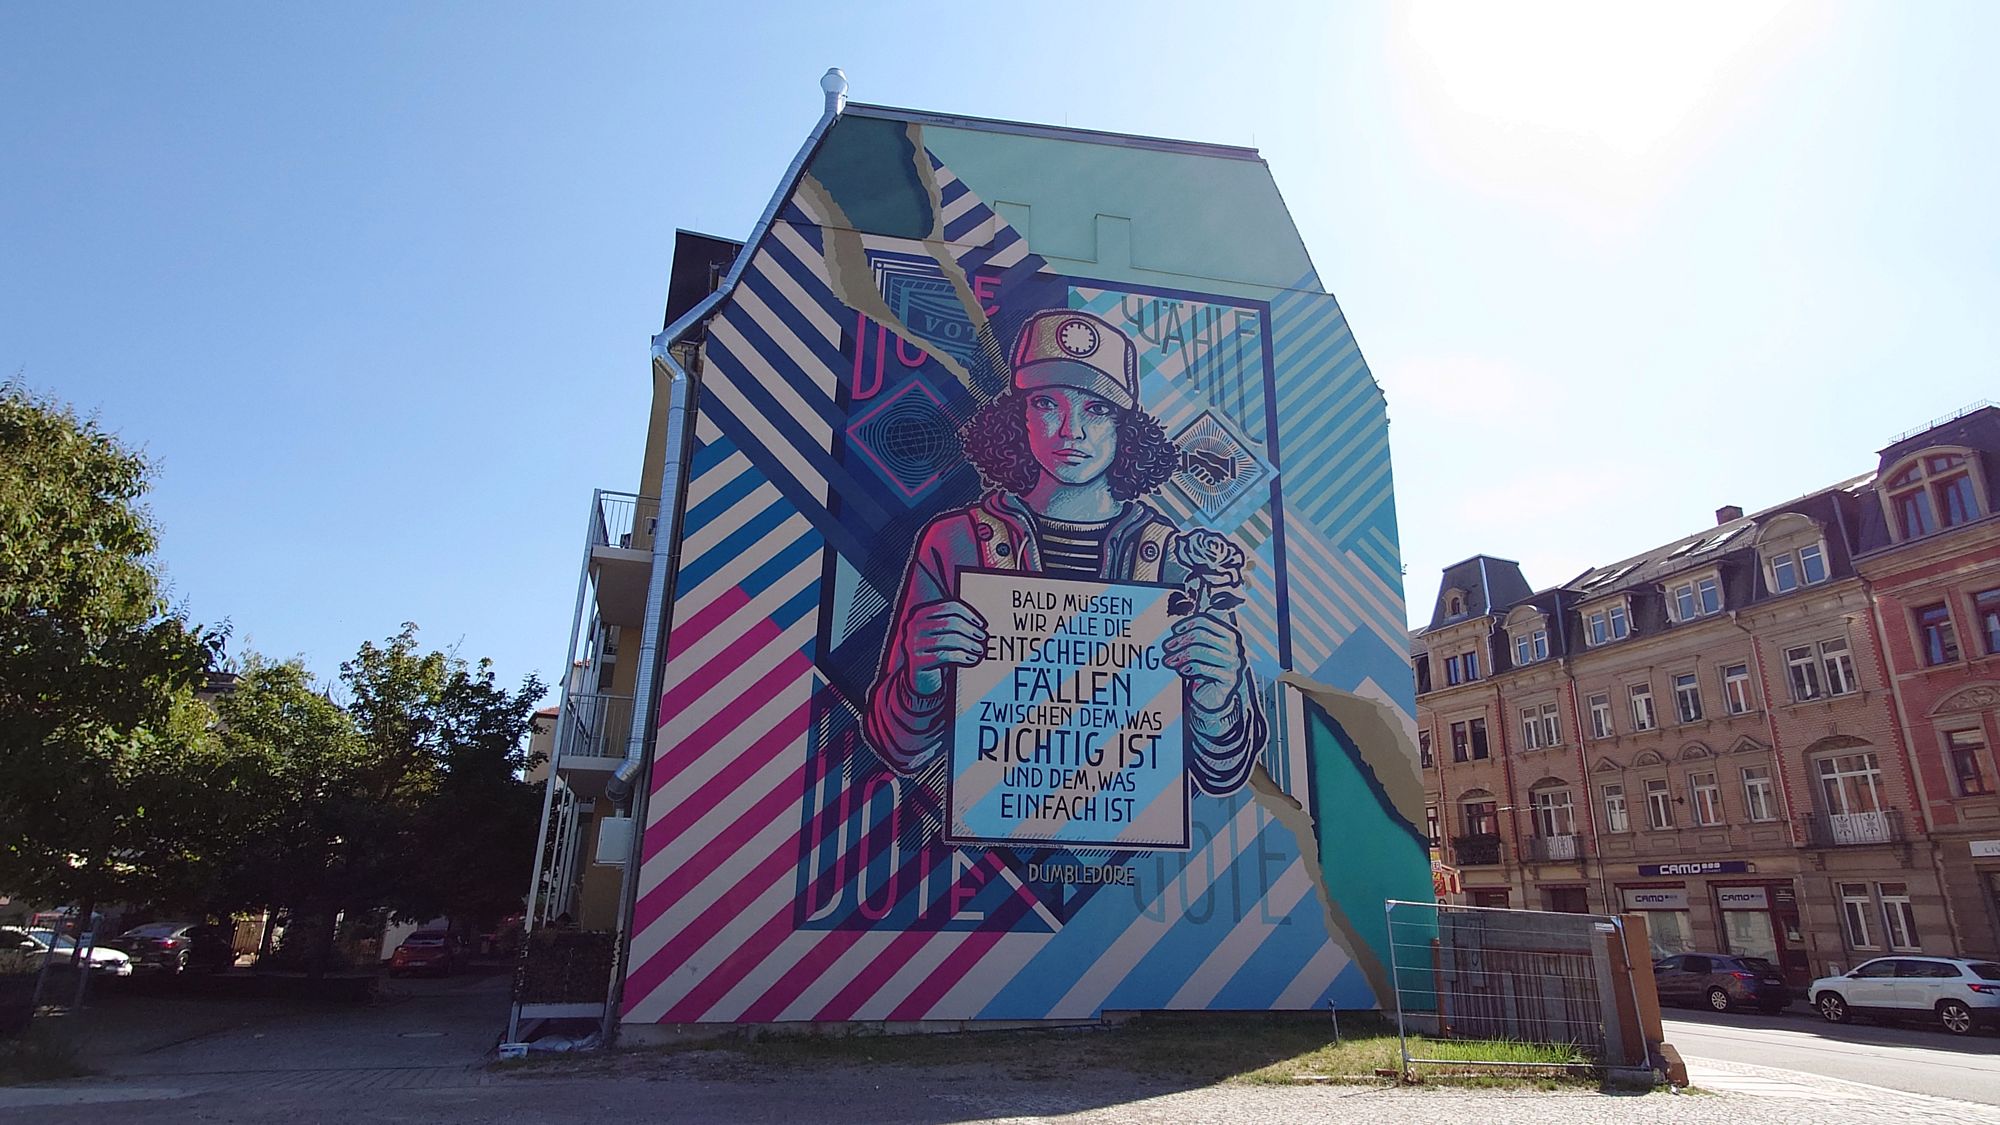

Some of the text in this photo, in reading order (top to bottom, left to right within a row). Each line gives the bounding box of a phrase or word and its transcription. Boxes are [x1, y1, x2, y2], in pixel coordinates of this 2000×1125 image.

[1012, 590, 1057, 610] BALD
[1013, 612, 1132, 638] WIR ALLE DIE
[985, 635, 1160, 670] ENTSCHEIDUNG
[1014, 666, 1131, 706] FÄLLEN
[979, 702, 1072, 726] ZWISCHEN
[1125, 711, 1162, 731] WAS
[978, 725, 1162, 769] RICHTIG IST
[1003, 766, 1043, 788] UND
[1098, 770, 1136, 792] WAS
[1001, 793, 1136, 822] EINFACH IST
[1028, 863, 1136, 886] DUMBLEDORE
[1659, 863, 1701, 875] CAMO
[1634, 894, 1664, 902] CAMO
